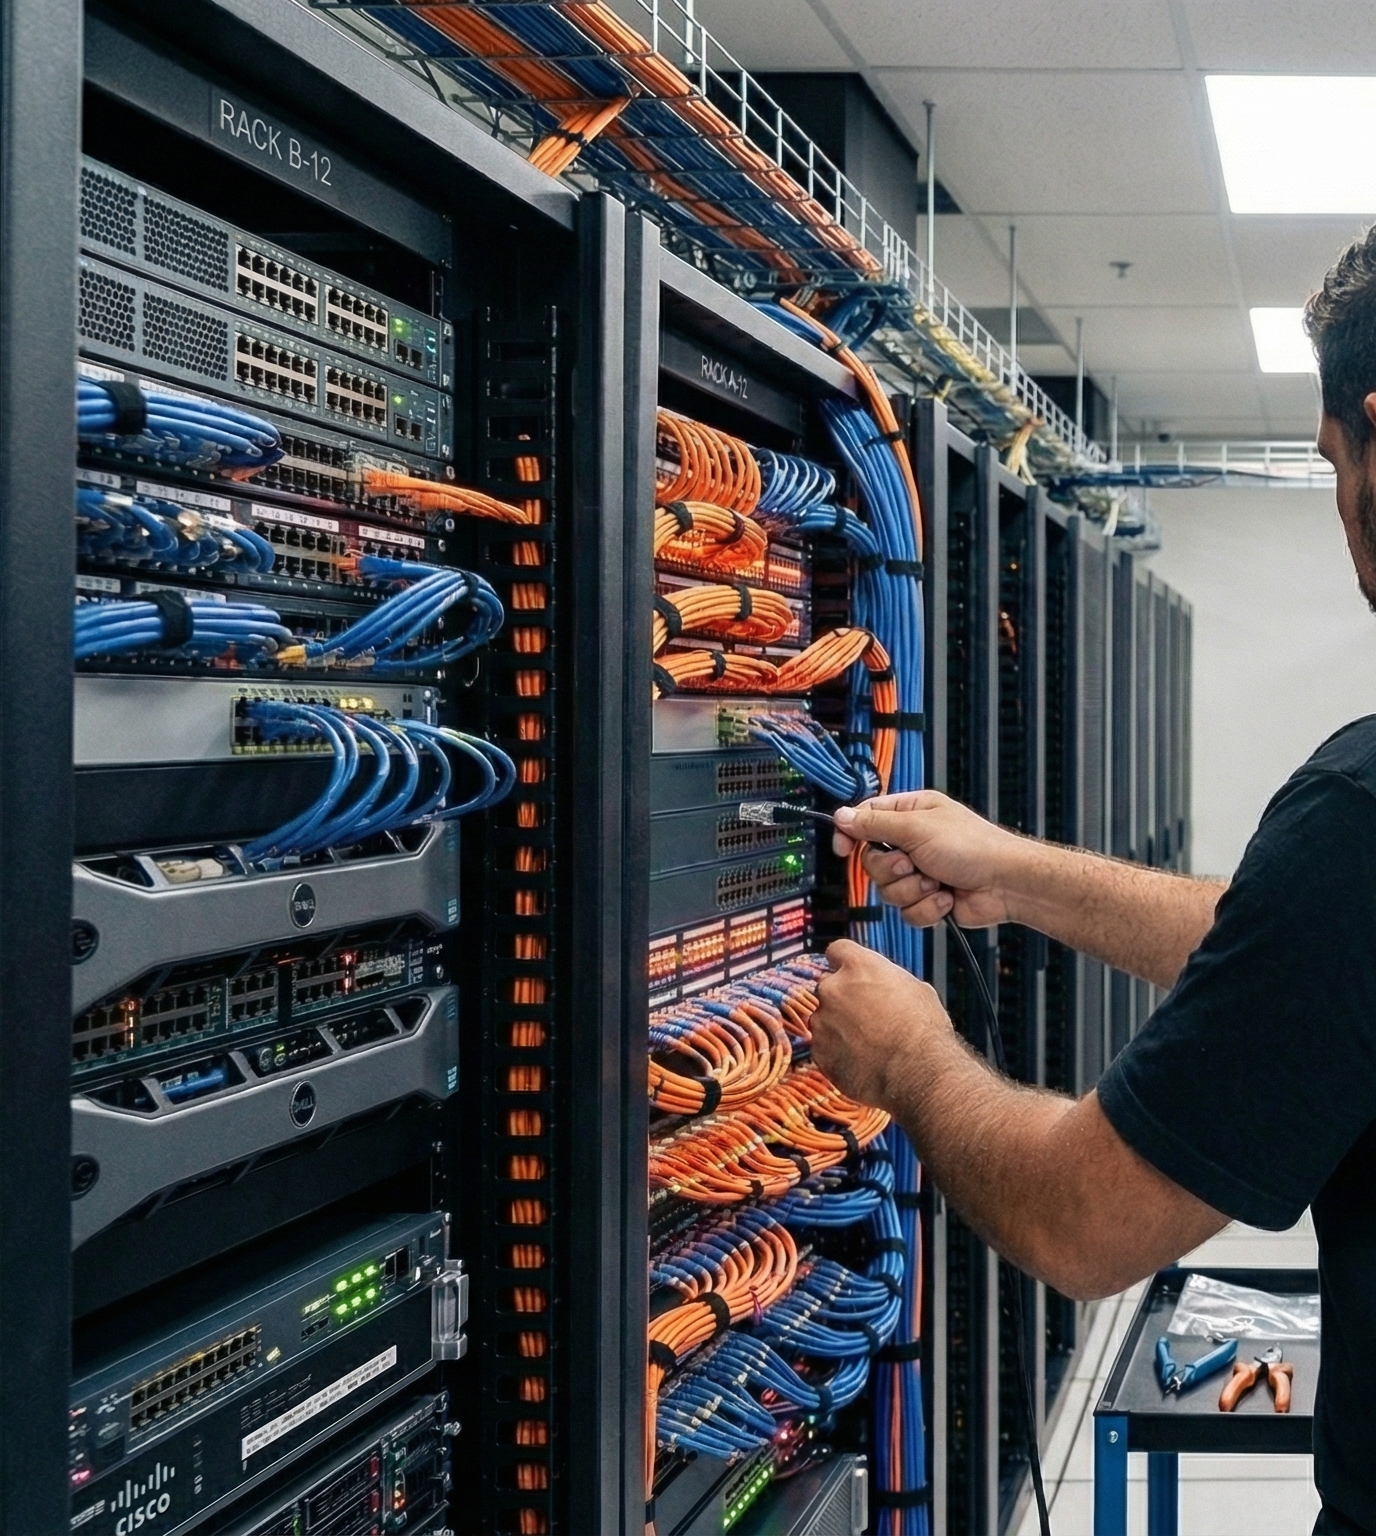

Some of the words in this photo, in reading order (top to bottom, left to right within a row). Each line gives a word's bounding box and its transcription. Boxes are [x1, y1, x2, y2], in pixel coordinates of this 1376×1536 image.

[220, 98, 283, 160] RACK
[289, 137, 332, 187] B-12
[701, 354, 729, 389] RACK
[115, 1492, 171, 1536] CISCO
